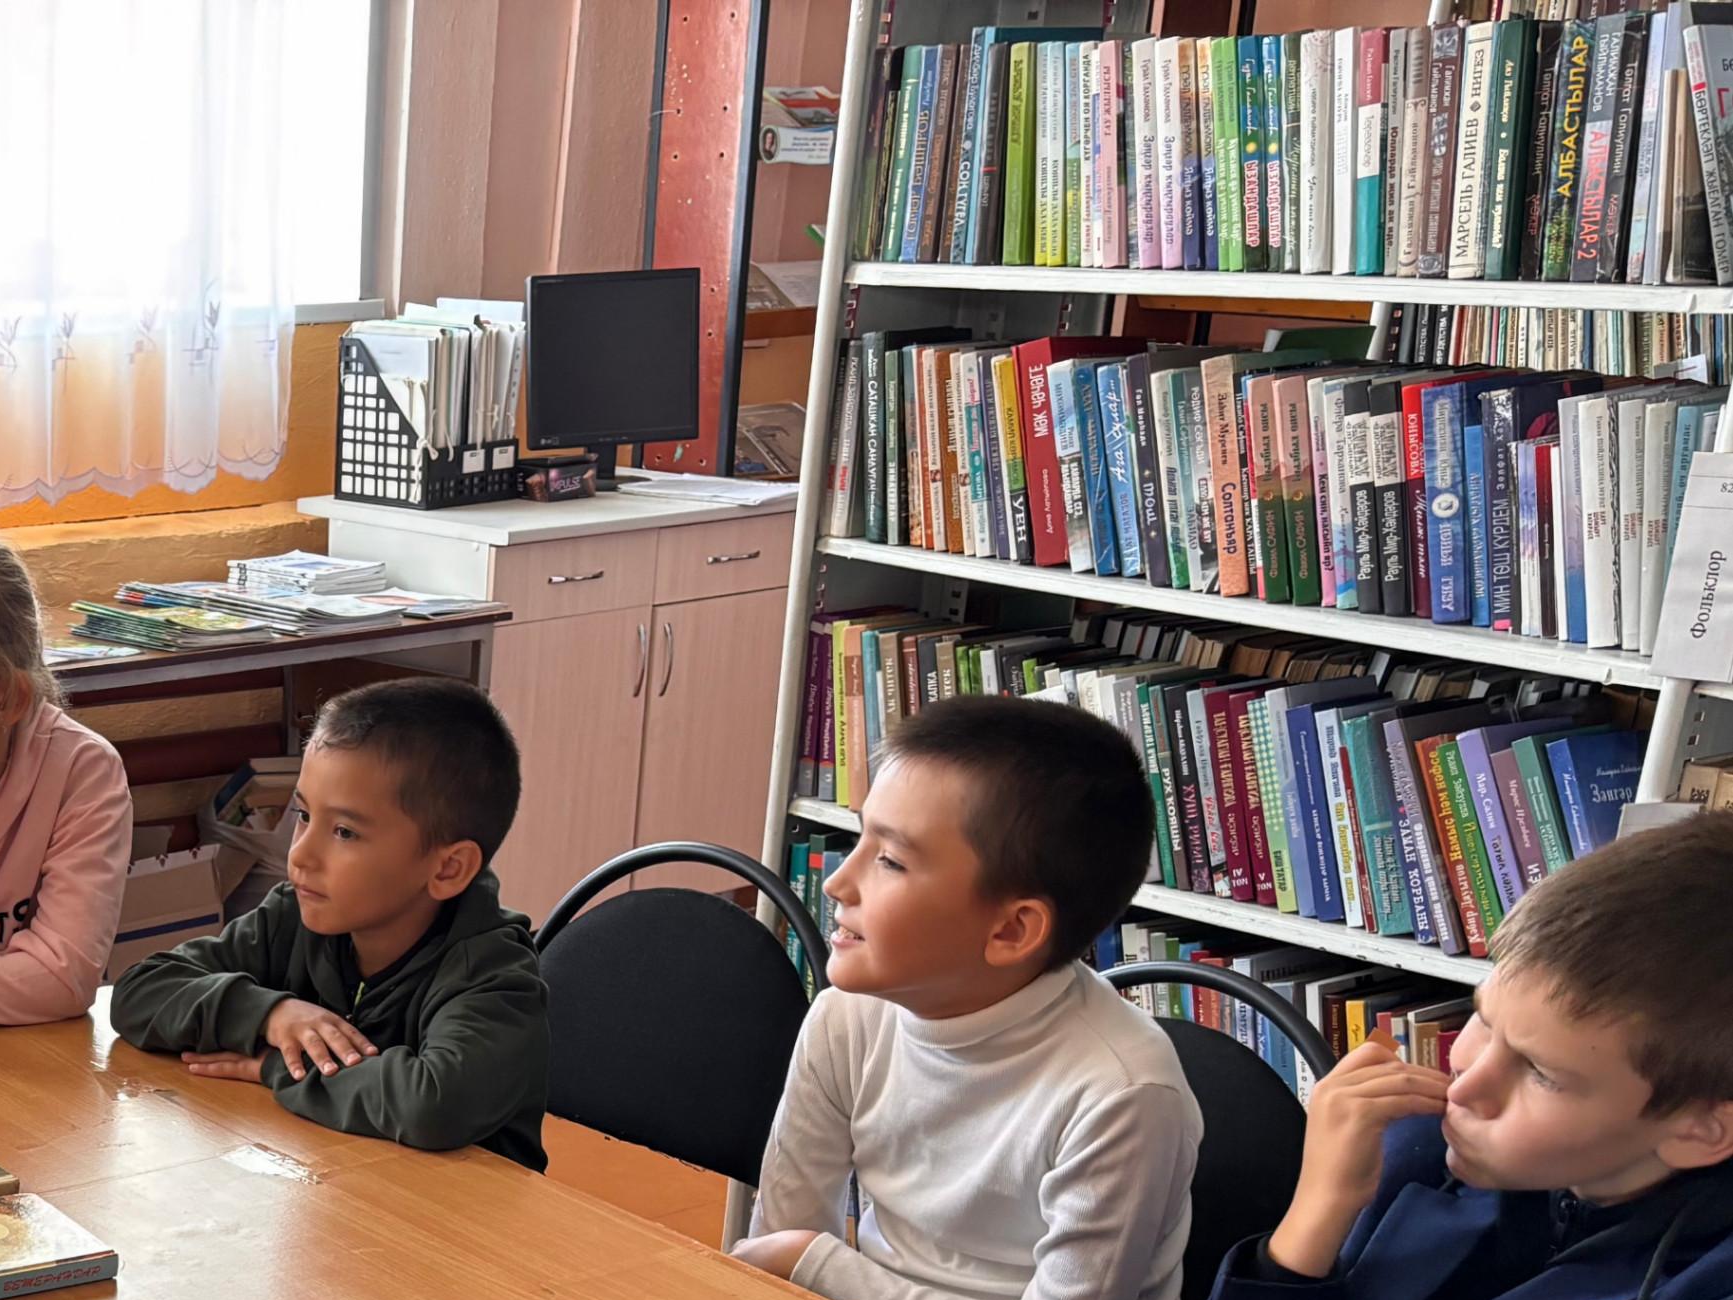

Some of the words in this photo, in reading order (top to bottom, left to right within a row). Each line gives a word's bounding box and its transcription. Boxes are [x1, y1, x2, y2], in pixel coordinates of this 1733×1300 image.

[1470, 48, 1484, 97] НИГЕЗ
[1556, 35, 1590, 198] АЛБАСТЫЛАР
[1461, 119, 1479, 180] ГАЛИЕВ
[1455, 184, 1473, 258] МАРСЕЛЬ
[866, 380, 878, 437] САТАШКАН
[1408, 413, 1418, 476] ЮНЫСОВА
[1013, 495, 1027, 543] УЕН
[1492, 498, 1511, 550] КҮРДЕМ
[1493, 553, 1511, 582] ТӨШ
[1493, 584, 1511, 614] МИН
[1690, 550, 1727, 639] Фольклор
[927, 671, 938, 702] КАПКА
[1162, 767, 1174, 793] РУХ
[1398, 820, 1413, 863] ЗАМАН
